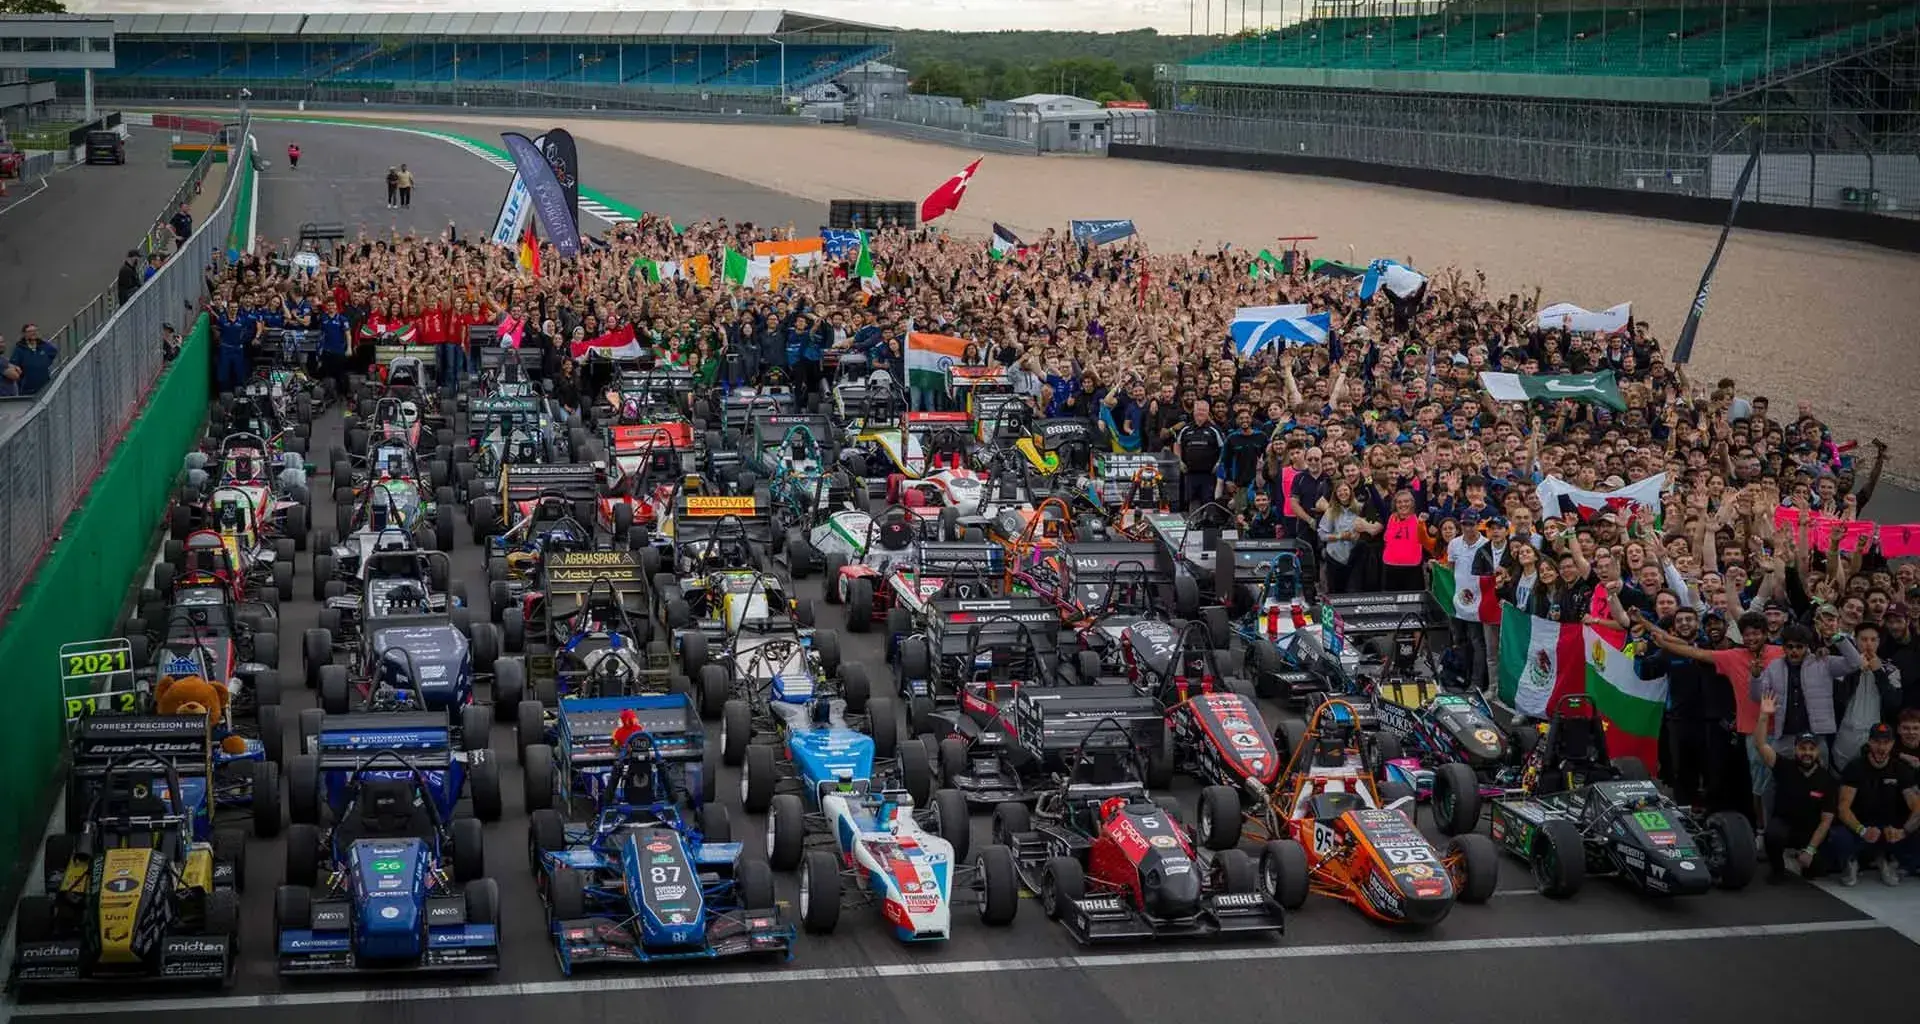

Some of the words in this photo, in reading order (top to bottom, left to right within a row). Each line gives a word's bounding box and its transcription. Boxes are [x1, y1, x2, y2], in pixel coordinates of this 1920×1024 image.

[689, 498, 752, 506] SANDVIK
[565, 553, 621, 564] AGEMASPARK
[69, 651, 126, 675] 2021
[120, 692, 134, 712] 2
[90, 722, 131, 730] FORREST
[134, 721, 183, 730] PRECISION
[1141, 817, 1161, 829] 5
[1316, 827, 1332, 851] 95
[1391, 849, 1429, 861] 95
[375, 861, 401, 871] 26
[650, 866, 681, 883] 87
[114, 879, 127, 891] 1
[1218, 894, 1264, 905] MAHLE
